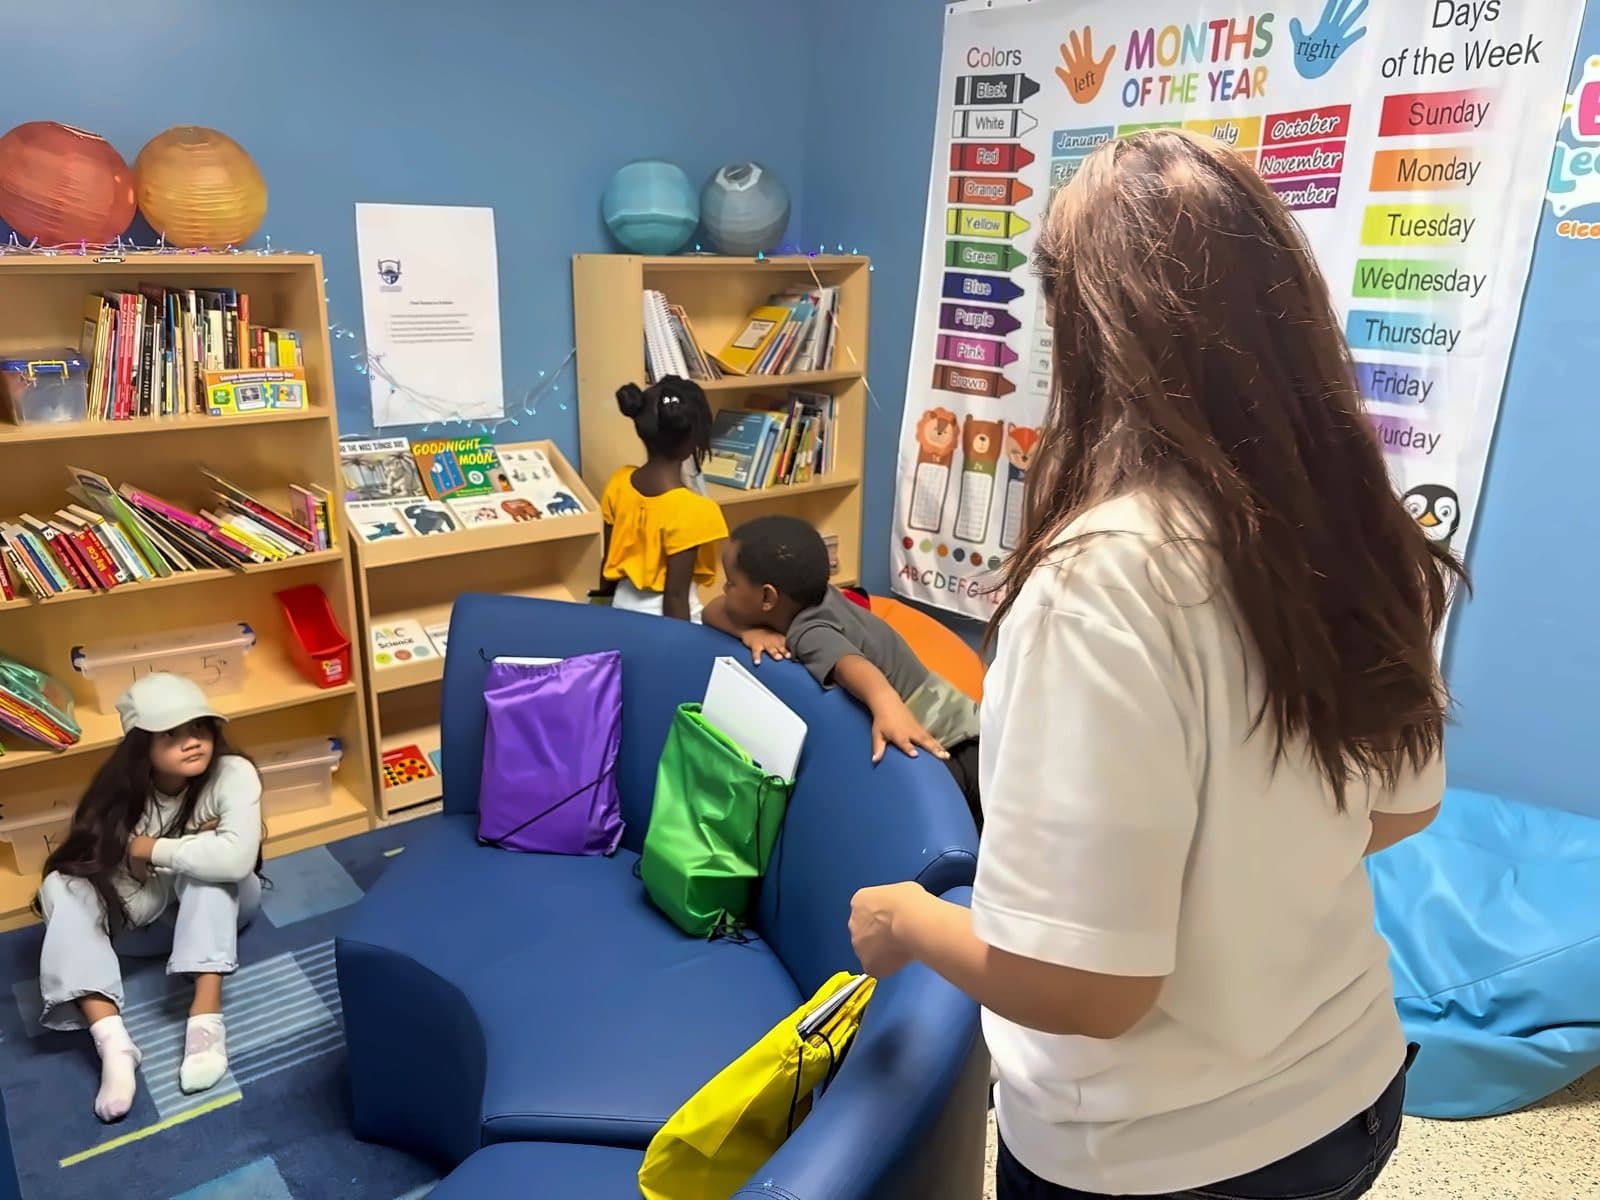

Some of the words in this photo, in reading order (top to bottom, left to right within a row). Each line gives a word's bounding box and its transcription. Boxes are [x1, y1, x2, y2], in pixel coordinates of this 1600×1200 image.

[1432, 0, 1501, 32] Days
[1124, 13, 1275, 71] MONTHS
[1296, 38, 1340, 61] right
[966, 47, 1022, 68] Colors
[1381, 48, 1409, 79] of
[1413, 46, 1455, 75] the
[1465, 33, 1543, 71] Week
[976, 82, 1007, 98] Black
[1073, 71, 1097, 95] left
[1122, 77, 1152, 108] OF
[1158, 73, 1199, 105] THE
[1207, 65, 1269, 102] YEAR
[975, 116, 1005, 130] White
[1408, 99, 1490, 127] Sunday
[1210, 120, 1239, 147] July
[1272, 114, 1339, 139] October
[976, 148, 1000, 165] Red
[1261, 148, 1341, 174] November
[1397, 156, 1482, 186] Monday
[965, 182, 1005, 199] Orange
[966, 217, 1001, 231] Yellow
[1387, 211, 1476, 243] Tuesday
[963, 248, 998, 264] Green
[963, 279, 992, 295] Blue
[1360, 267, 1487, 298] Wednesday
[955, 308, 995, 329] Purple
[1365, 318, 1461, 352] Thursday
[957, 343, 984, 360] Pink
[950, 372, 988, 390] Brown
[1371, 369, 1433, 403] Friday
[413, 438, 481, 456] GOODNIGHT
[1377, 424, 1441, 455] turday
[459, 452, 493, 465] MOON
